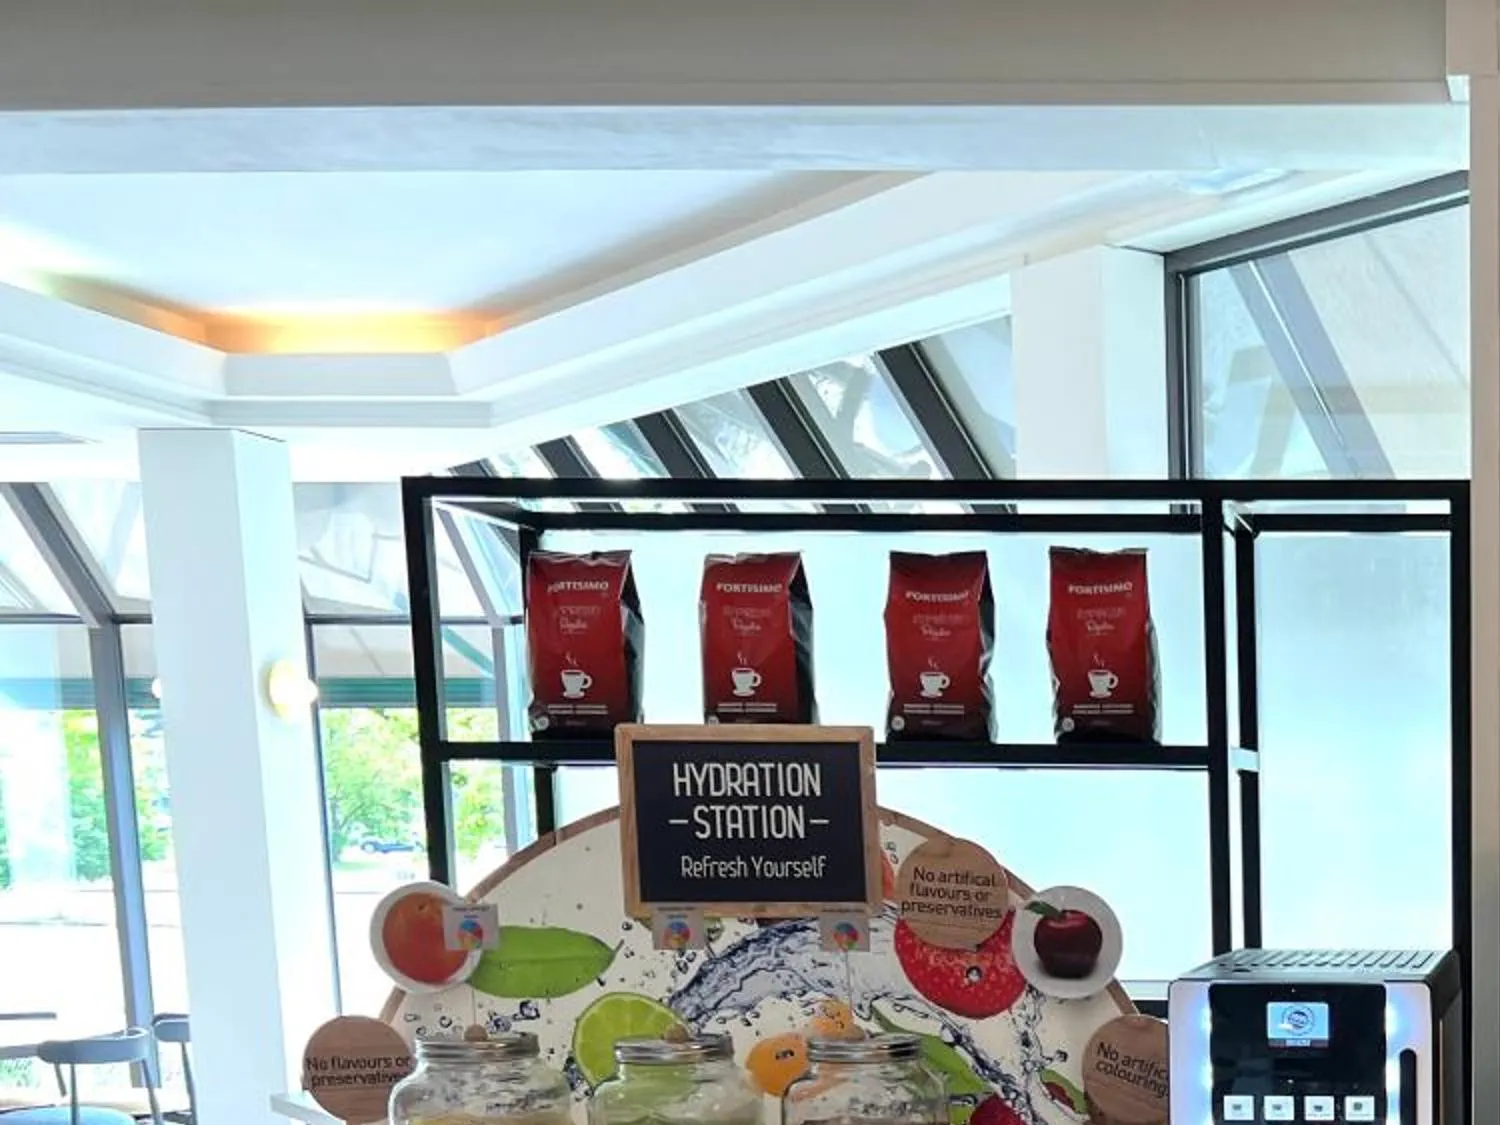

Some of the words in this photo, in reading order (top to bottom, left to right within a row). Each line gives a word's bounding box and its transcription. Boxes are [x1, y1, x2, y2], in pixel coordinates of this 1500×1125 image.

[672, 762, 822, 798] HYDRATION
[681, 855, 749, 878] Refresh
[751, 855, 827, 878] Yourself
[913, 866, 935, 882] No
[910, 881, 970, 901] flavours
[975, 891, 992, 902] or
[901, 900, 1002, 919] preservatives
[305, 1057, 329, 1071] No
[331, 1055, 393, 1069] flavours
[395, 1056, 411, 1067] or
[1097, 1042, 1119, 1062] No
[1121, 1055, 1168, 1079] artific
[1096, 1060, 1169, 1099] colouring
